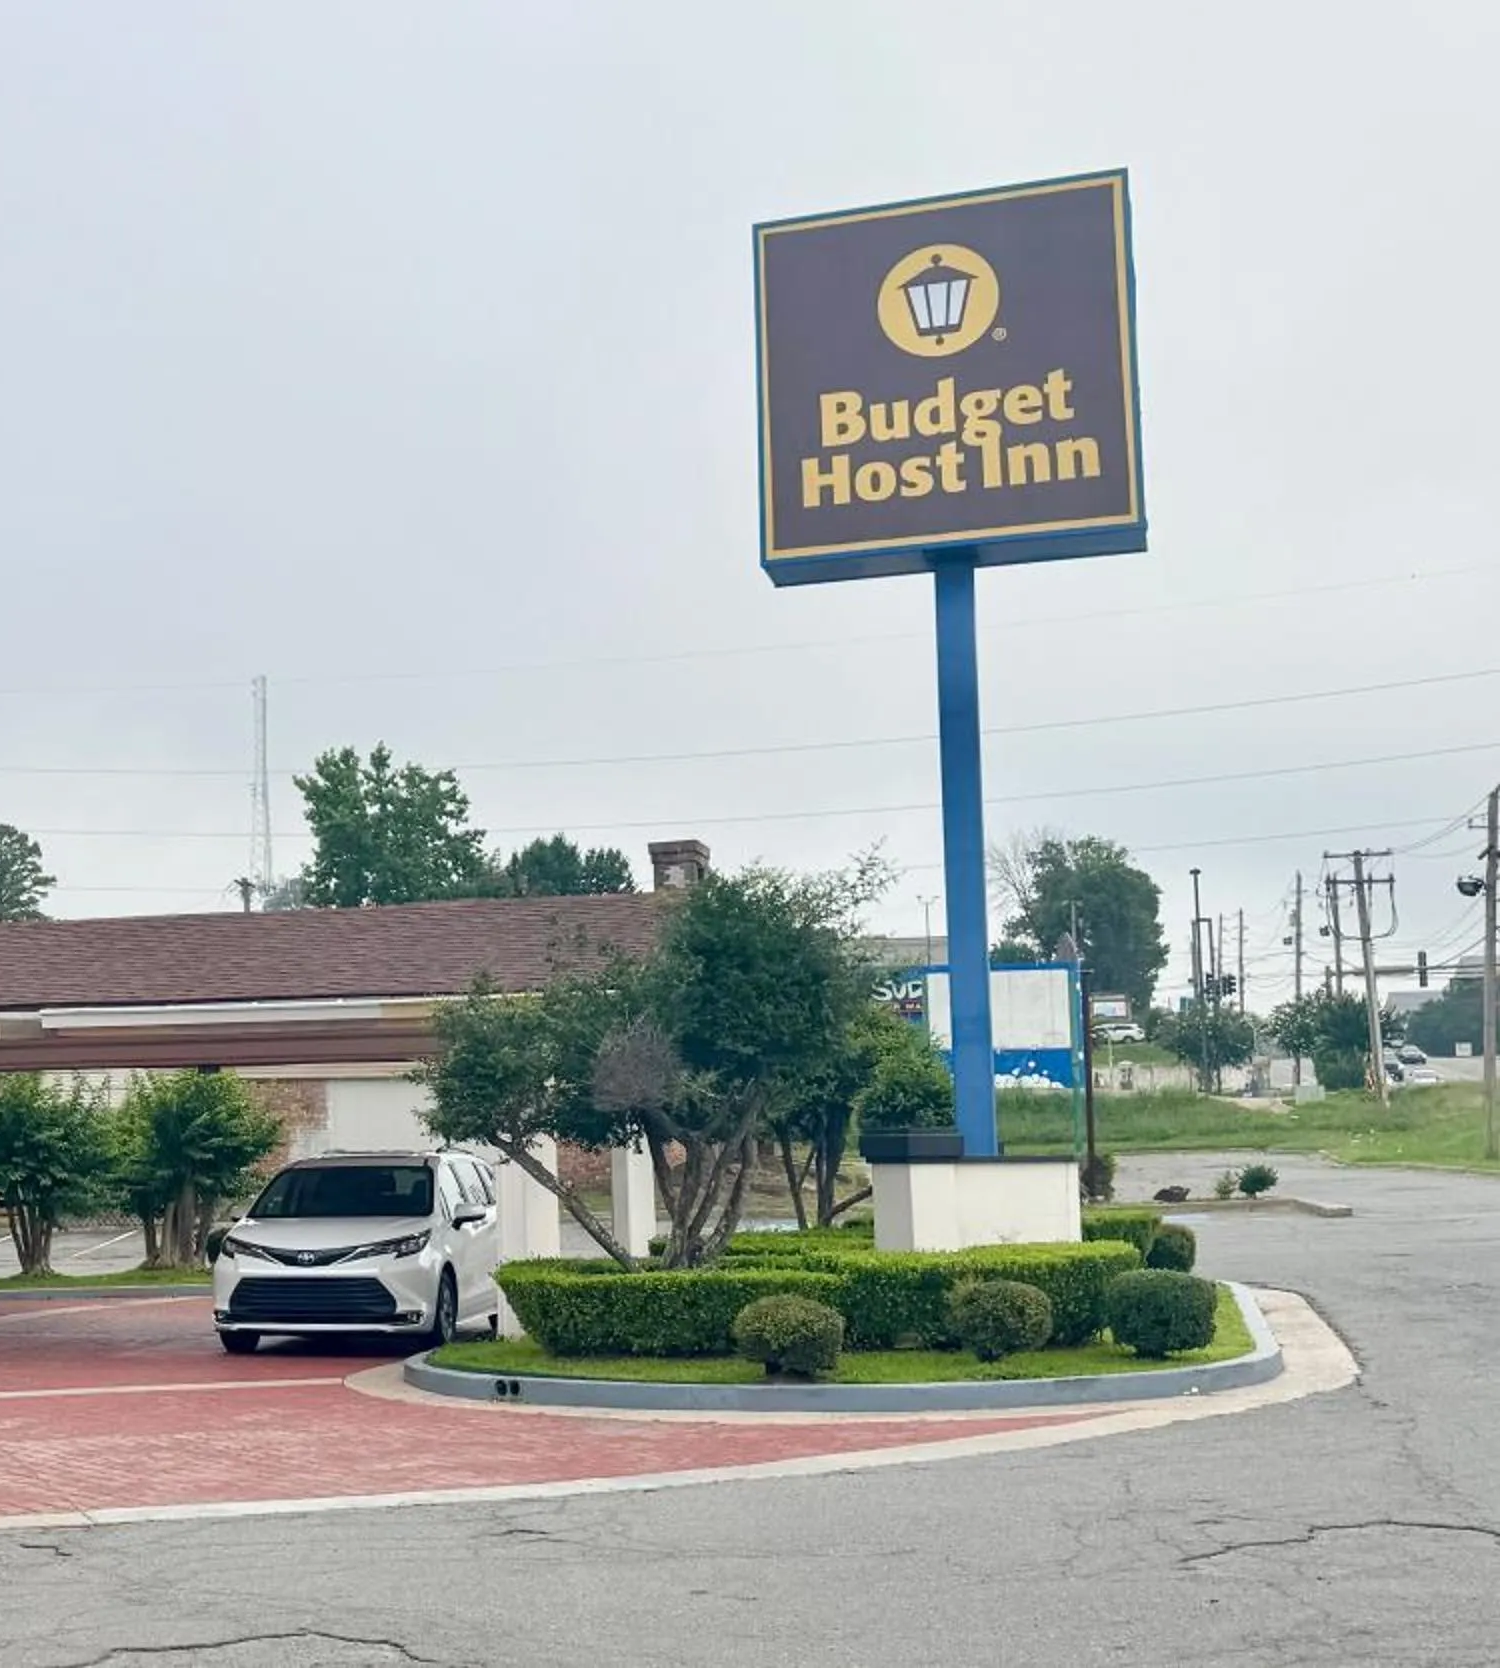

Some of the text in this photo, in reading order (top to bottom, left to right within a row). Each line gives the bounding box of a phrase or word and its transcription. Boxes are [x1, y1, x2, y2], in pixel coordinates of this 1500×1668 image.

[819, 368, 1074, 447] Budget
[801, 431, 1100, 508] Host Inn
